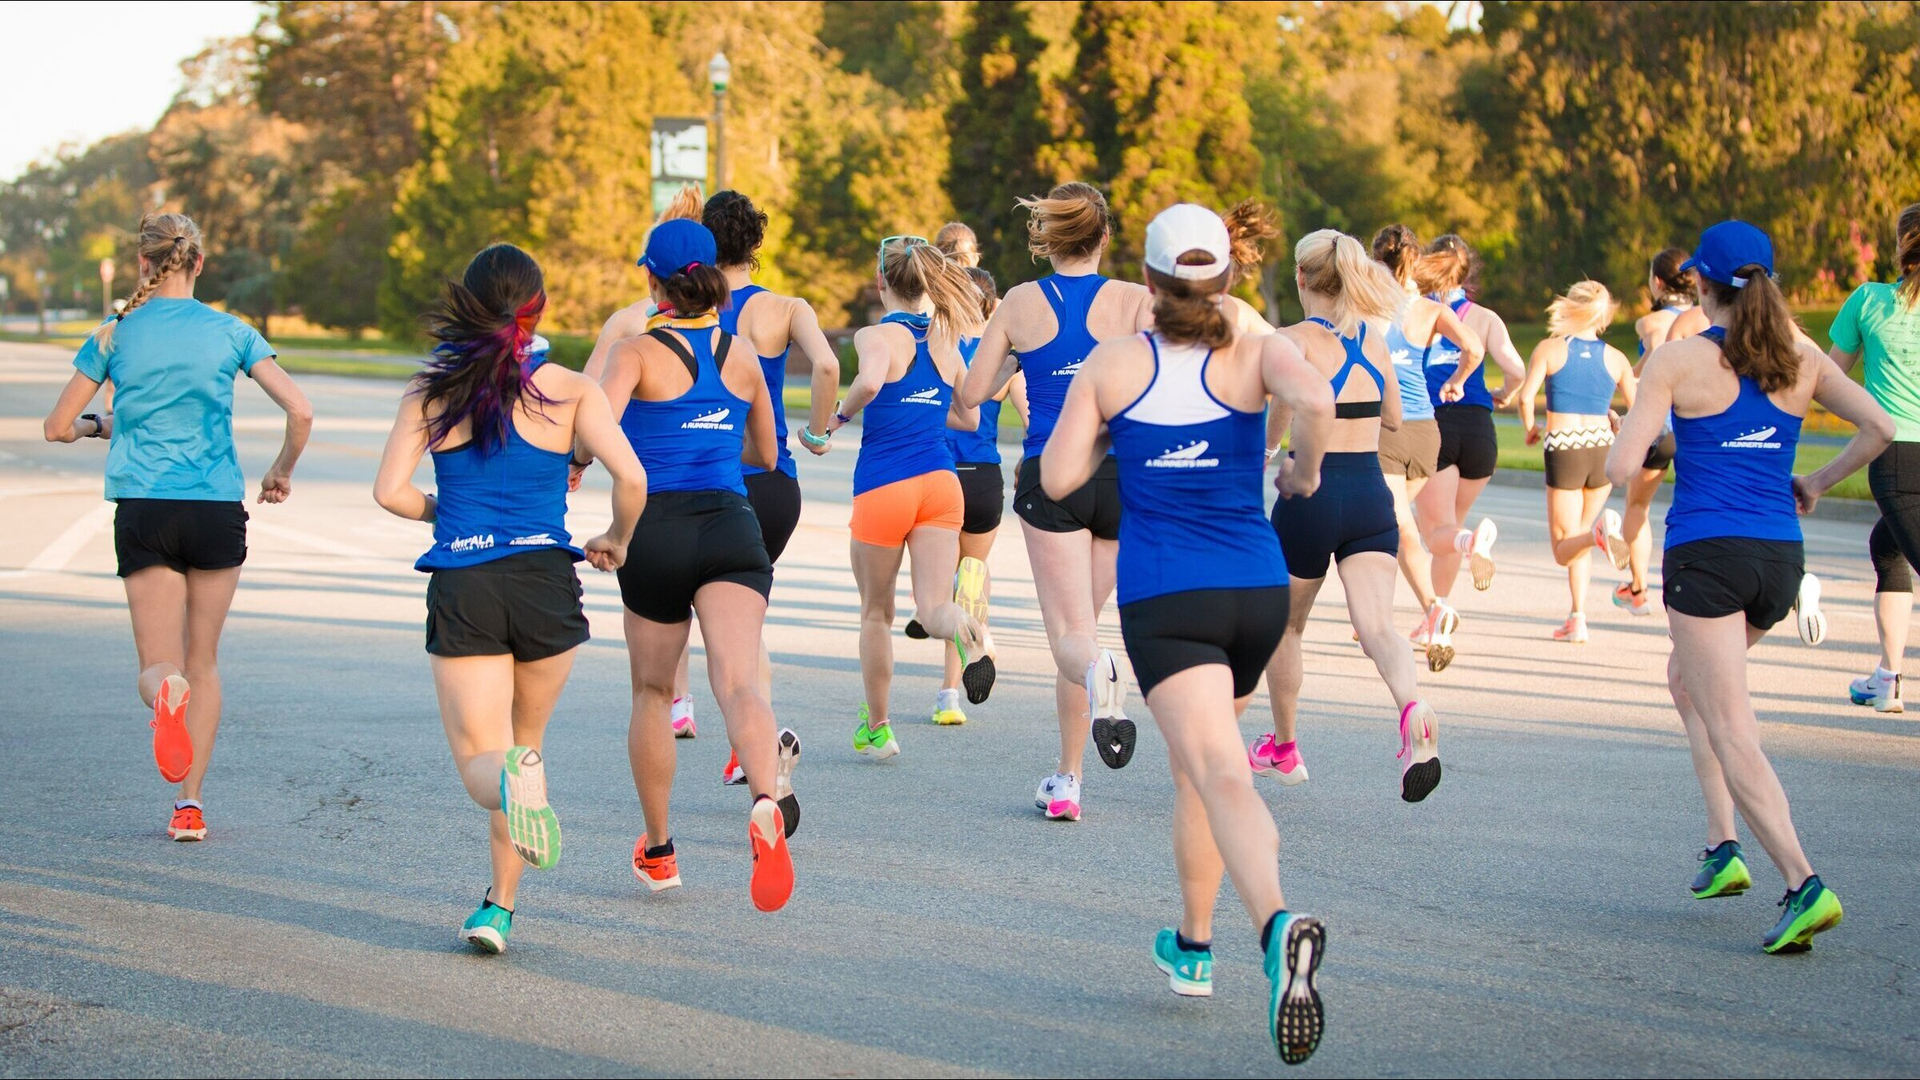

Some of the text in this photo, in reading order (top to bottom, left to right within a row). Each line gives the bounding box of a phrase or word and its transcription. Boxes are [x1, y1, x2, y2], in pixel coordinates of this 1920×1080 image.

[688, 422, 718, 430] RUNNER'S
[1728, 441, 1763, 449] RUNNER'S
[1145, 458, 1219, 468] A RUNNER'S MIND
